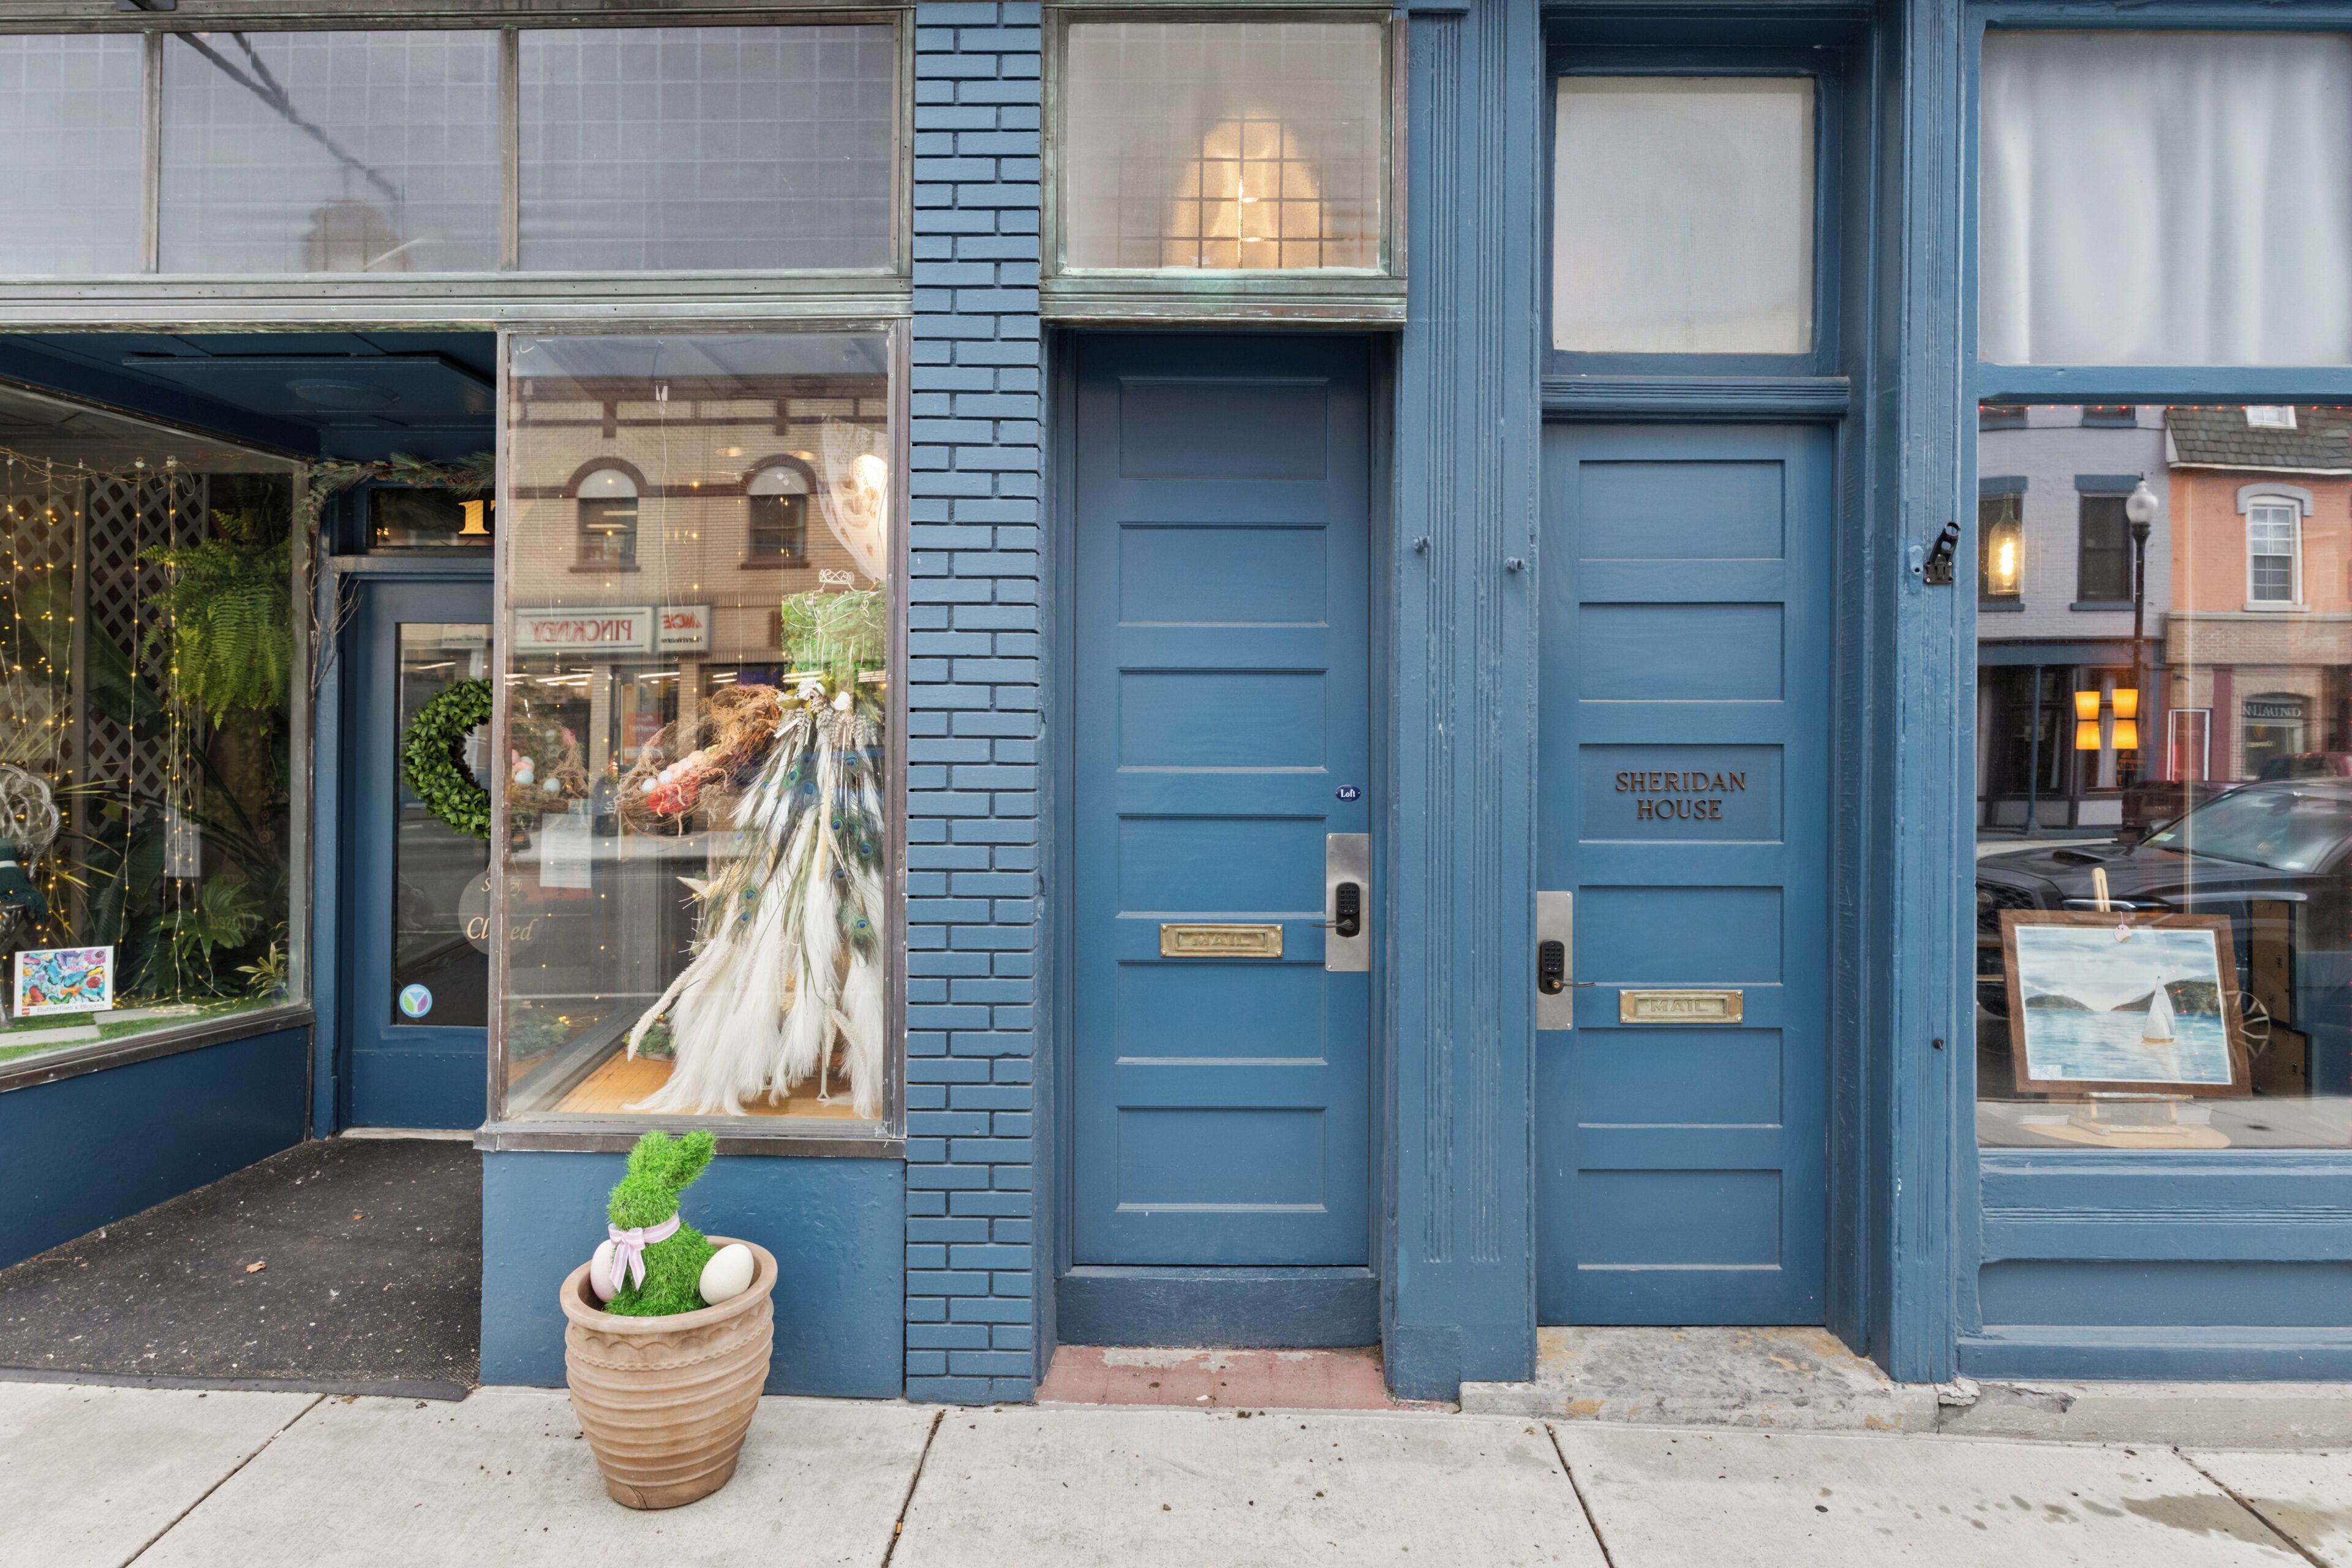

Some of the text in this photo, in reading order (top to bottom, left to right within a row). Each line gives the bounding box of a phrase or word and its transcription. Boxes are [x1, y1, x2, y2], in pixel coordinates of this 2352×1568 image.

[458, 499, 496, 534] 1
[1615, 771, 1746, 792] SHERIDAN
[1340, 789, 1356, 798] Loft
[1637, 799, 1723, 820] HOUSE
[467, 917, 539, 941] Cled
[1192, 933, 1250, 946] MAIL
[1650, 999, 1709, 1012] MAIL
